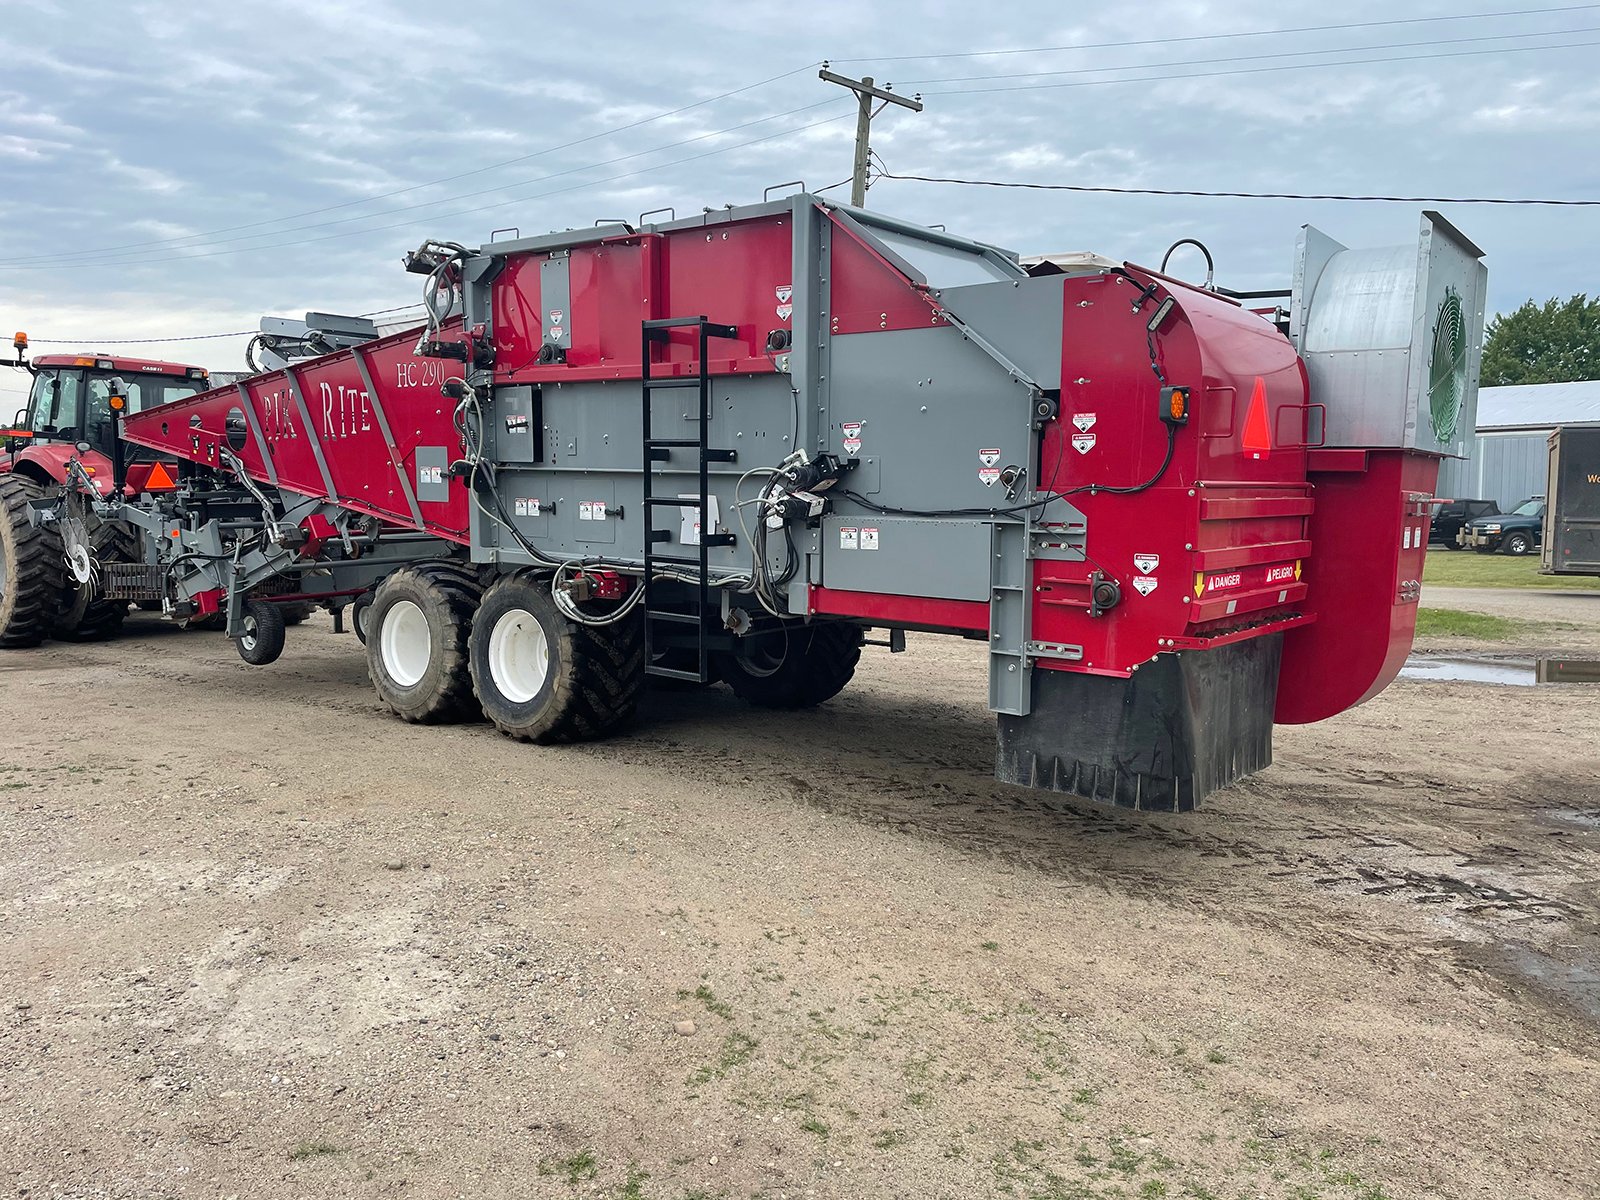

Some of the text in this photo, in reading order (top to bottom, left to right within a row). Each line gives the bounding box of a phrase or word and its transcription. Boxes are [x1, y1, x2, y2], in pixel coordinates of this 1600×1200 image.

[396, 361, 445, 388] HC 290
[264, 382, 371, 440] PIK RITE
[1215, 574, 1240, 588] DANGER
[1272, 566, 1293, 580] PELIGRO
